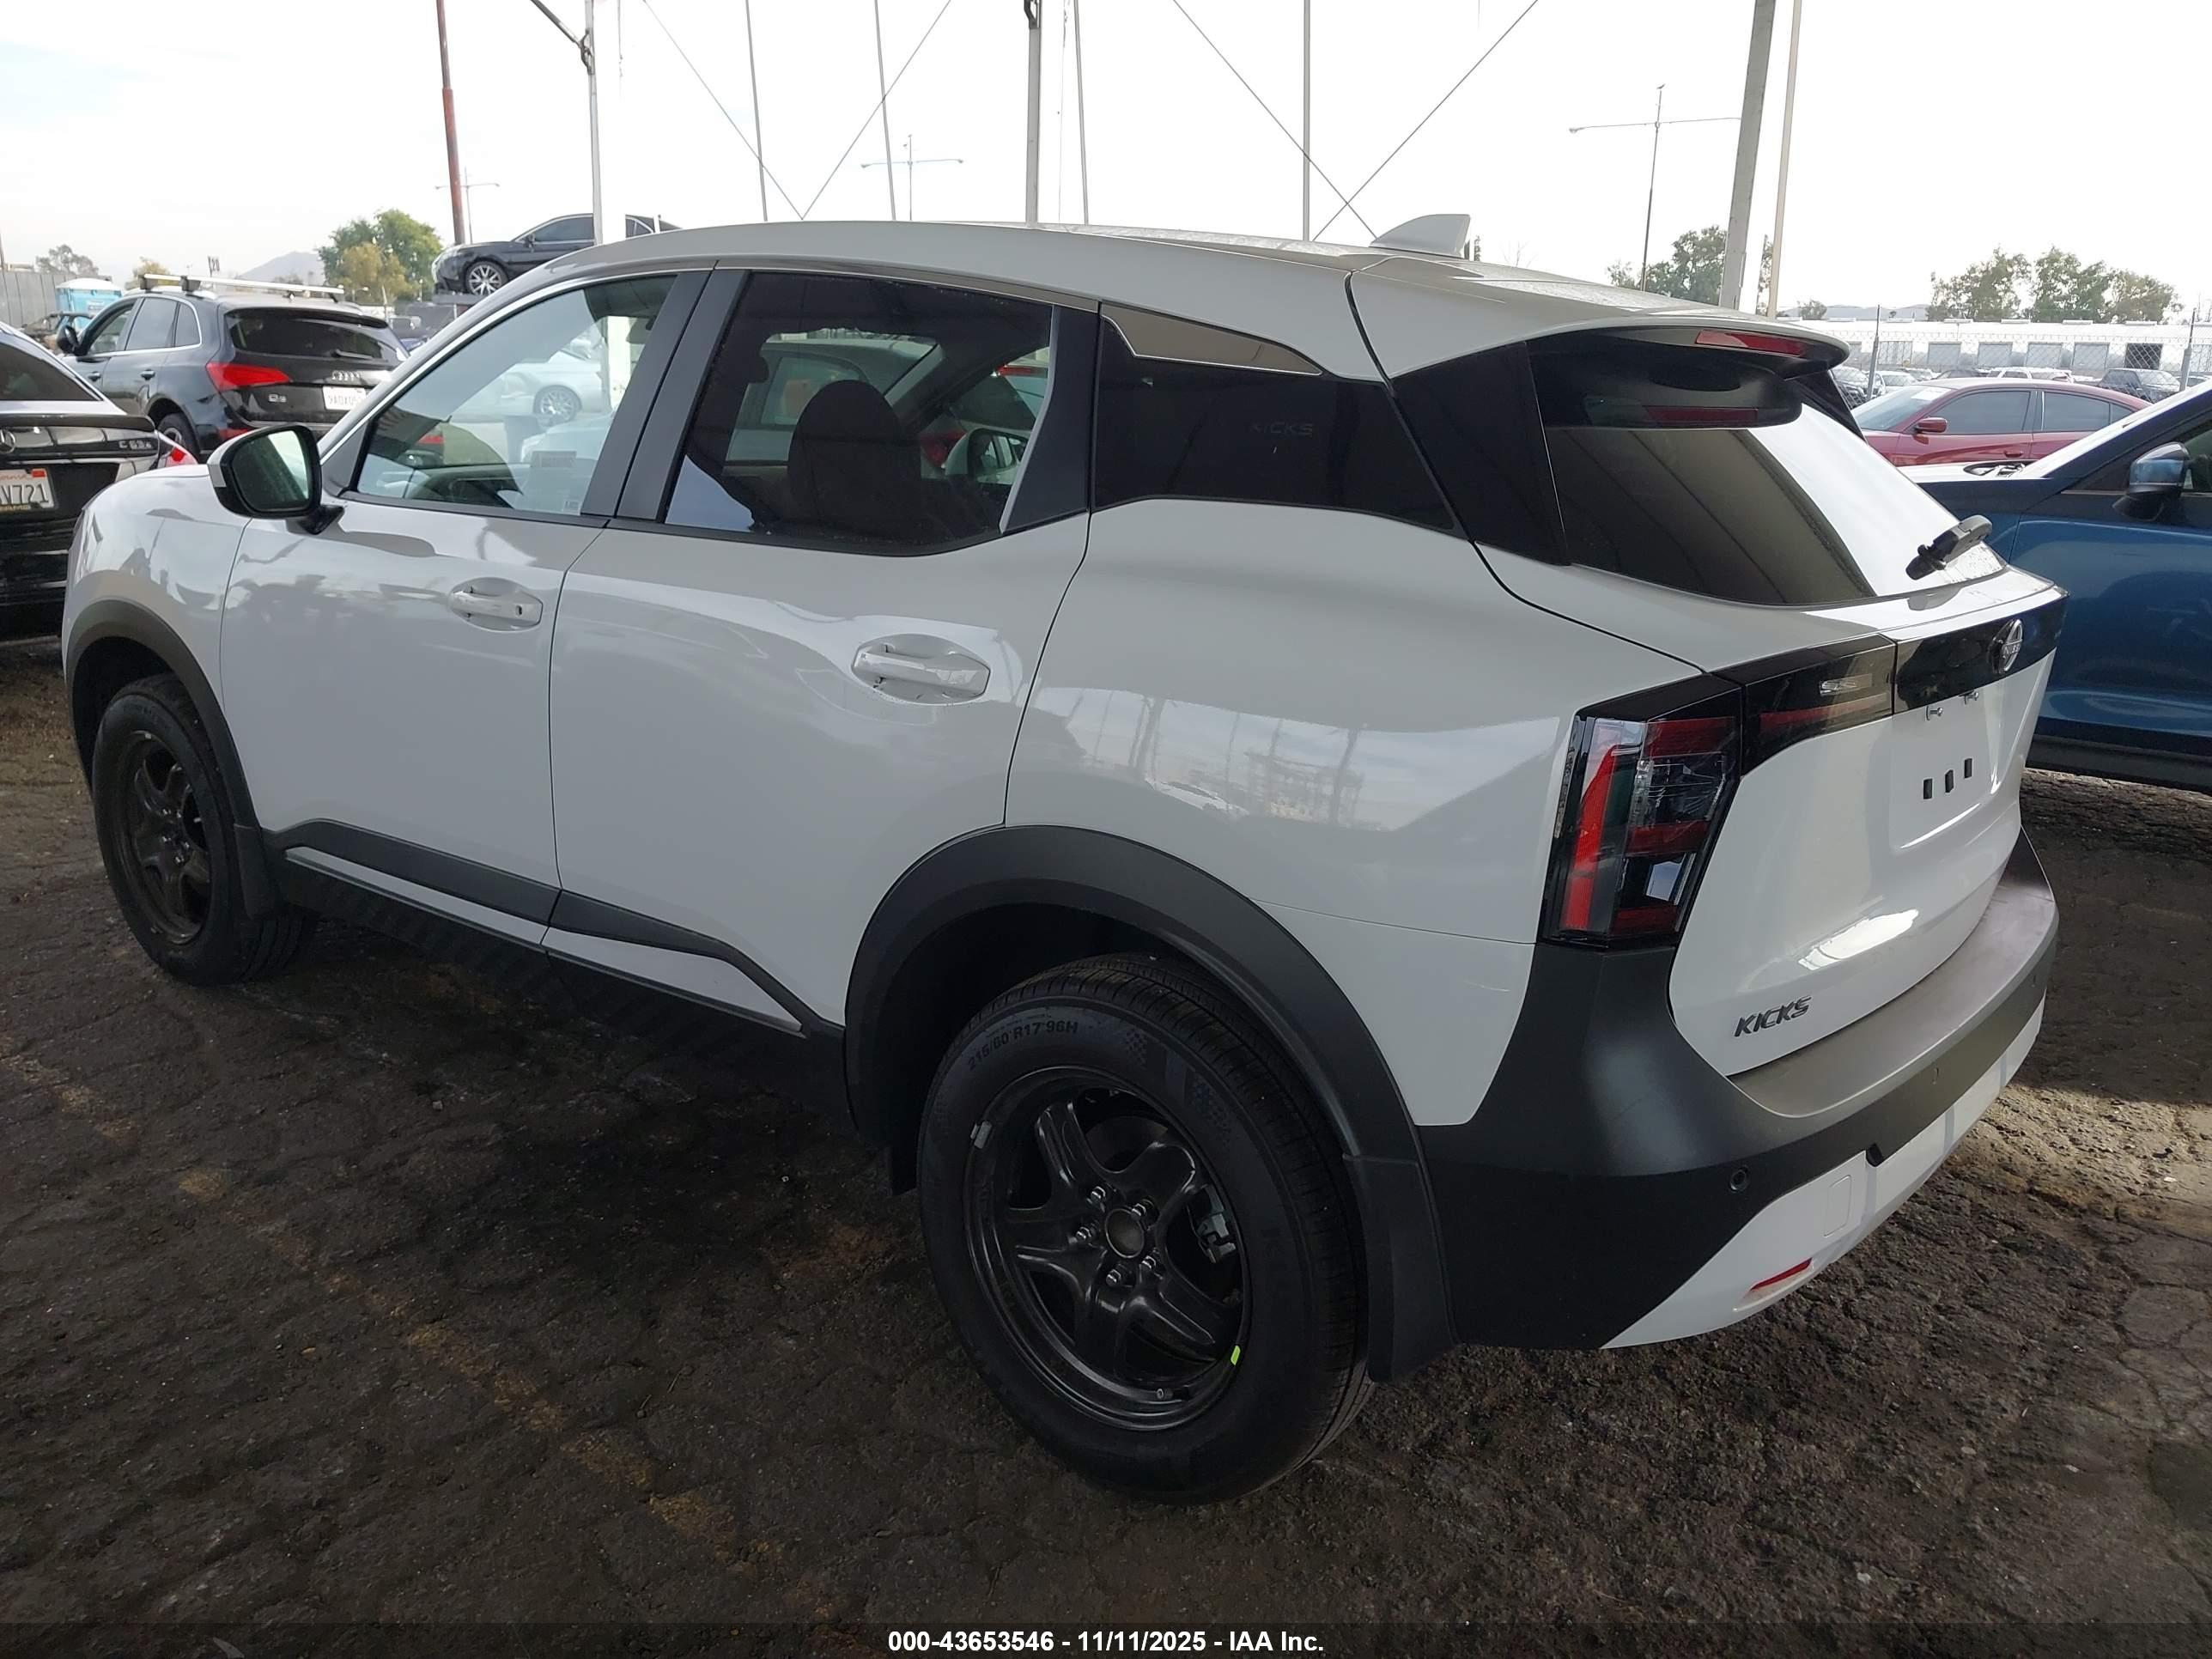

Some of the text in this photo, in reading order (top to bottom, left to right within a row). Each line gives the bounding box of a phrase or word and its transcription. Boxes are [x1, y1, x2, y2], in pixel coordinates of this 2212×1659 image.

[1250, 422, 1314, 438] KICKS
[0, 483, 49, 505] V721
[1734, 995, 1813, 1037] KICKS
[1014, 1022, 1042, 1039] R17
[1045, 1020, 1079, 1035] 96H
